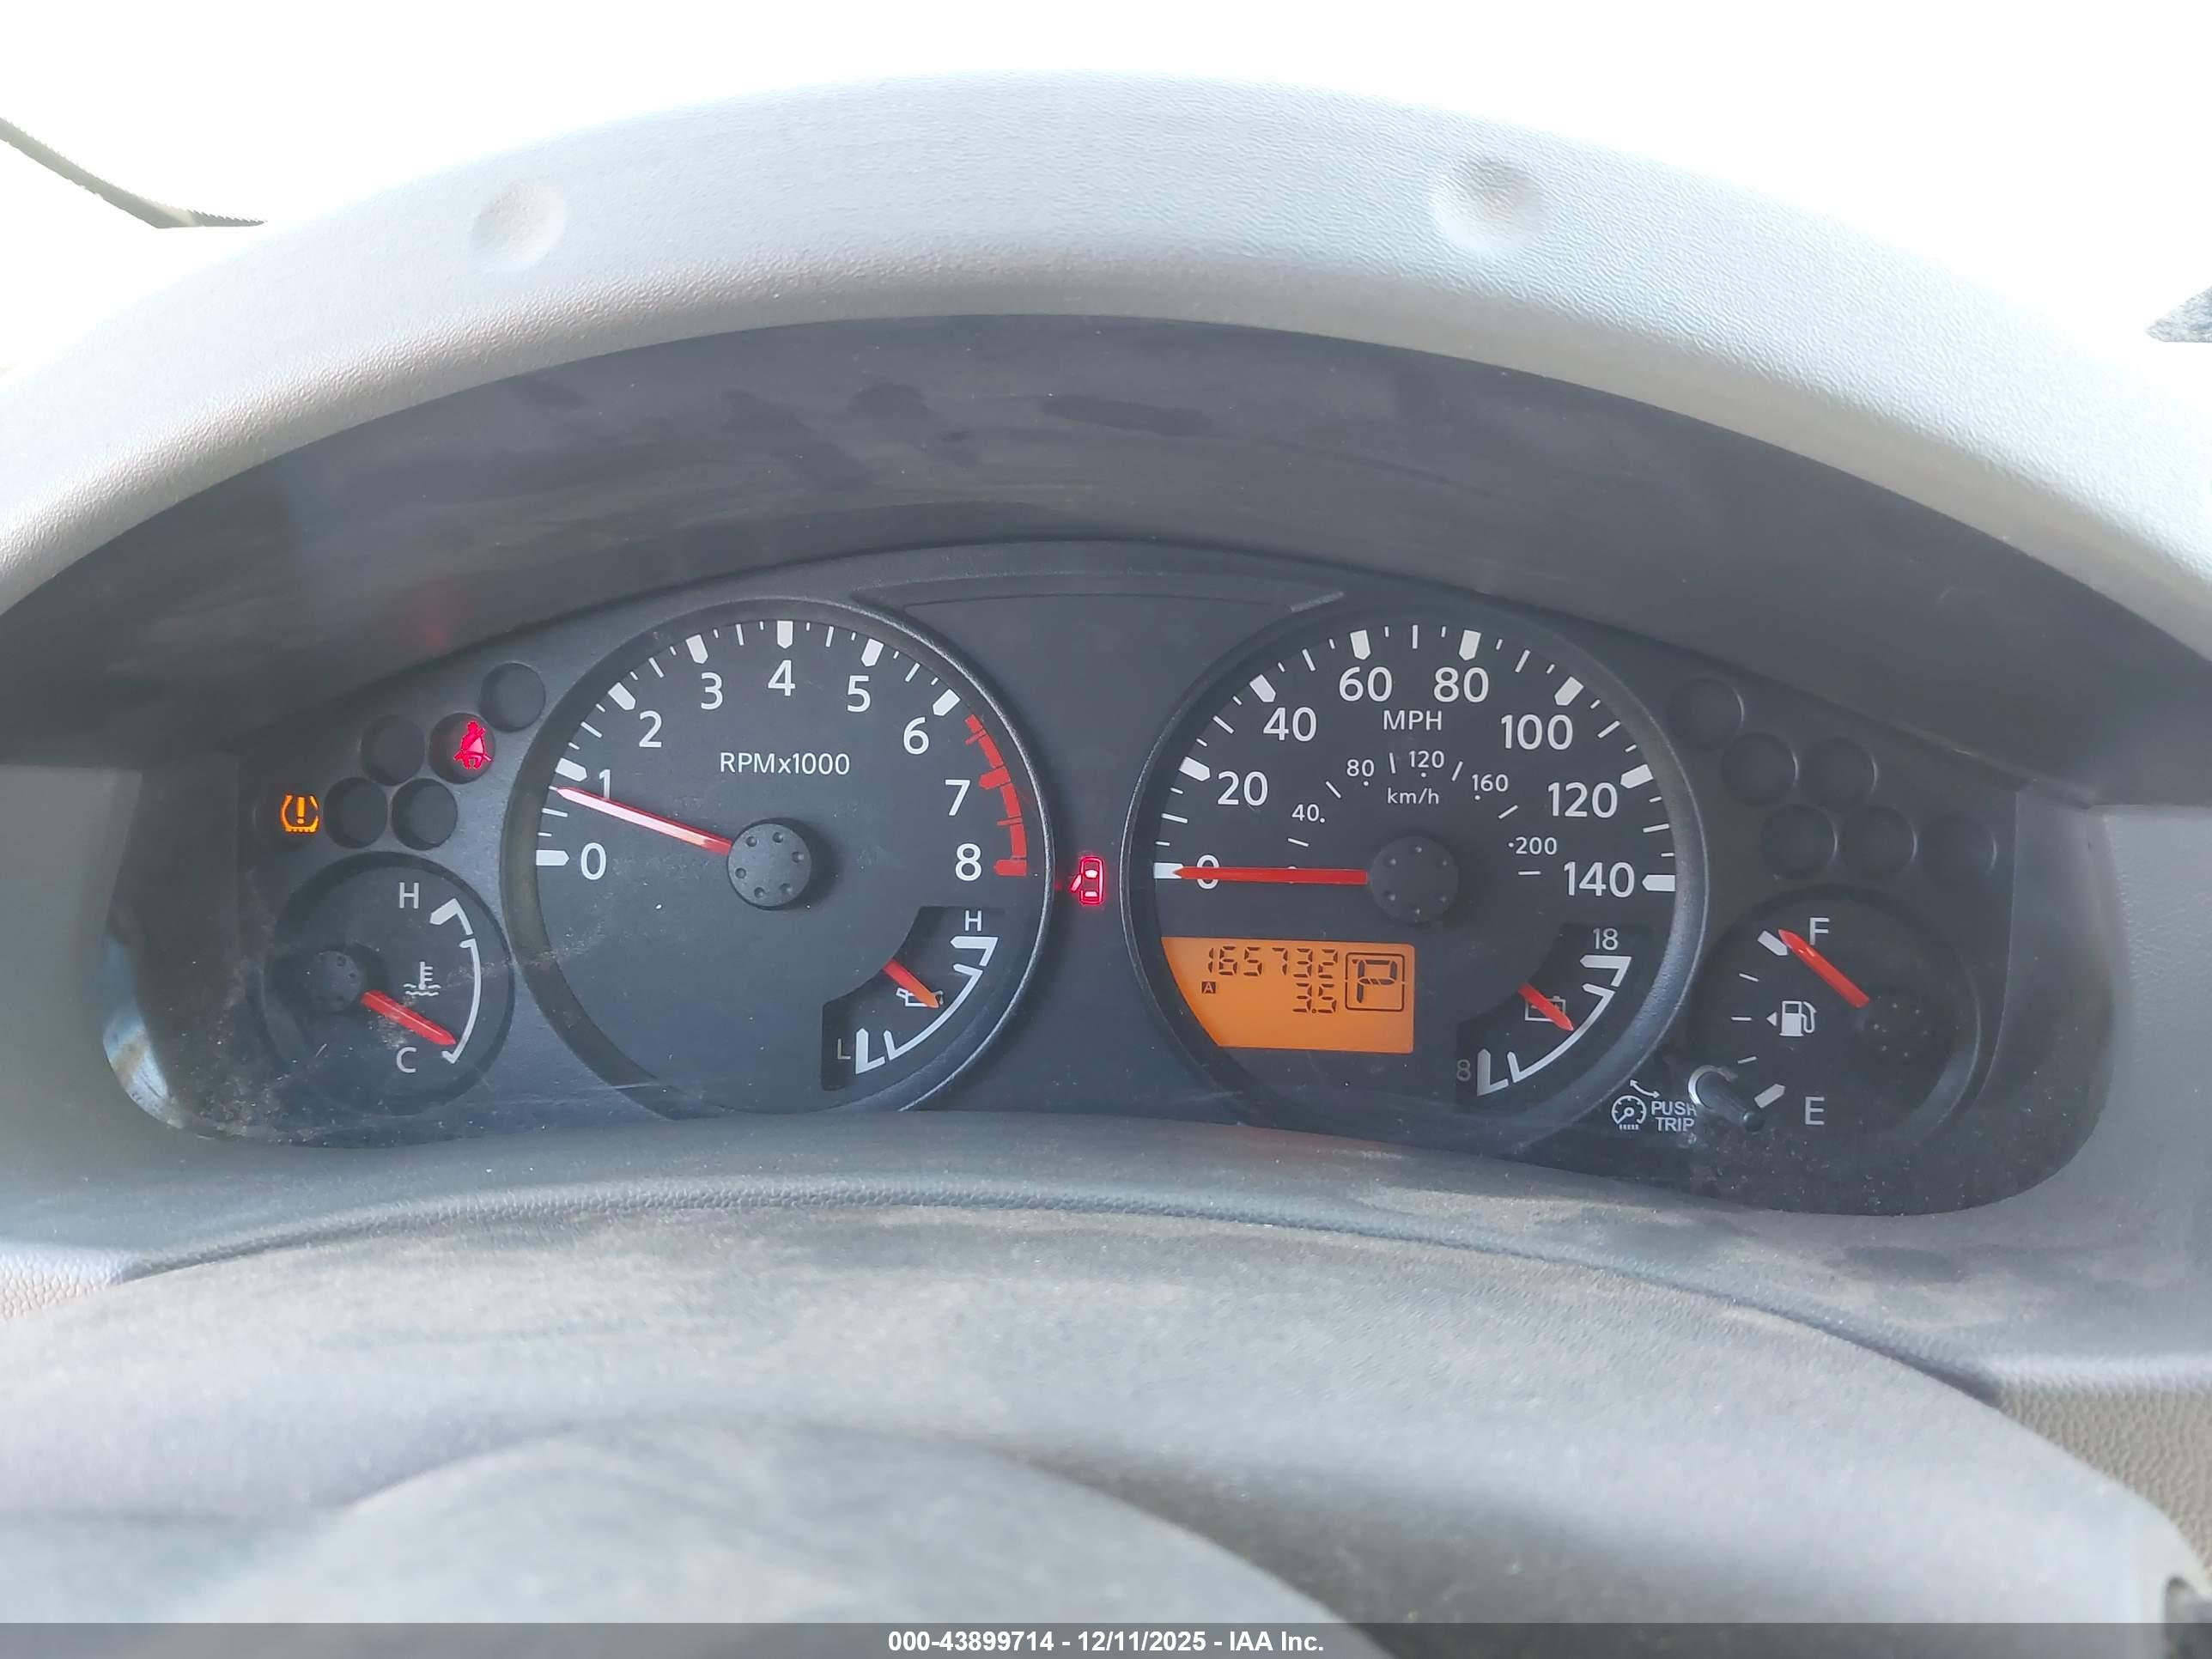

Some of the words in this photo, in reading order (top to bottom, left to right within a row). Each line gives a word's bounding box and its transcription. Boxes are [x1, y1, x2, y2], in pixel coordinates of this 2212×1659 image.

[701, 672, 724, 710] 3
[768, 659, 796, 696] 4
[1338, 666, 1393, 702] 60
[1433, 667, 1489, 703] 80
[847, 675, 871, 713] 5
[639, 711, 663, 748] 2
[902, 716, 930, 755] 6
[1263, 707, 1317, 742] 40
[1382, 710, 1443, 732] MPH
[1501, 714, 1574, 750] 100
[720, 751, 850, 776] RPMx1000
[1346, 758, 1375, 777] 80
[1409, 750, 1445, 769] 120
[599, 769, 611, 799] 1
[945, 780, 971, 816] 7
[1217, 771, 1269, 807] 20
[1387, 787, 1439, 805] km/h
[1472, 774, 1510, 793] 160
[1291, 804, 1320, 823] 40
[1547, 781, 1619, 818] 120
[580, 842, 606, 880] 0
[1515, 837, 1558, 855] 200
[956, 842, 981, 881] 8
[1564, 861, 1635, 898] 140
[399, 882, 420, 908] H
[964, 910, 982, 931] H
[1809, 917, 1830, 945] F
[1593, 928, 1618, 950] 18
[1208, 946, 1338, 979] 165732
[1352, 959, 1398, 1003] P
[1292, 982, 1337, 1013] 3.5
[396, 1046, 417, 1073] C
[837, 1039, 851, 1060] L
[1456, 1060, 1471, 1082] 8
[1651, 1100, 1697, 1117] PUSH
[1805, 1097, 1826, 1126] E
[1656, 1117, 1695, 1133] TRIP
